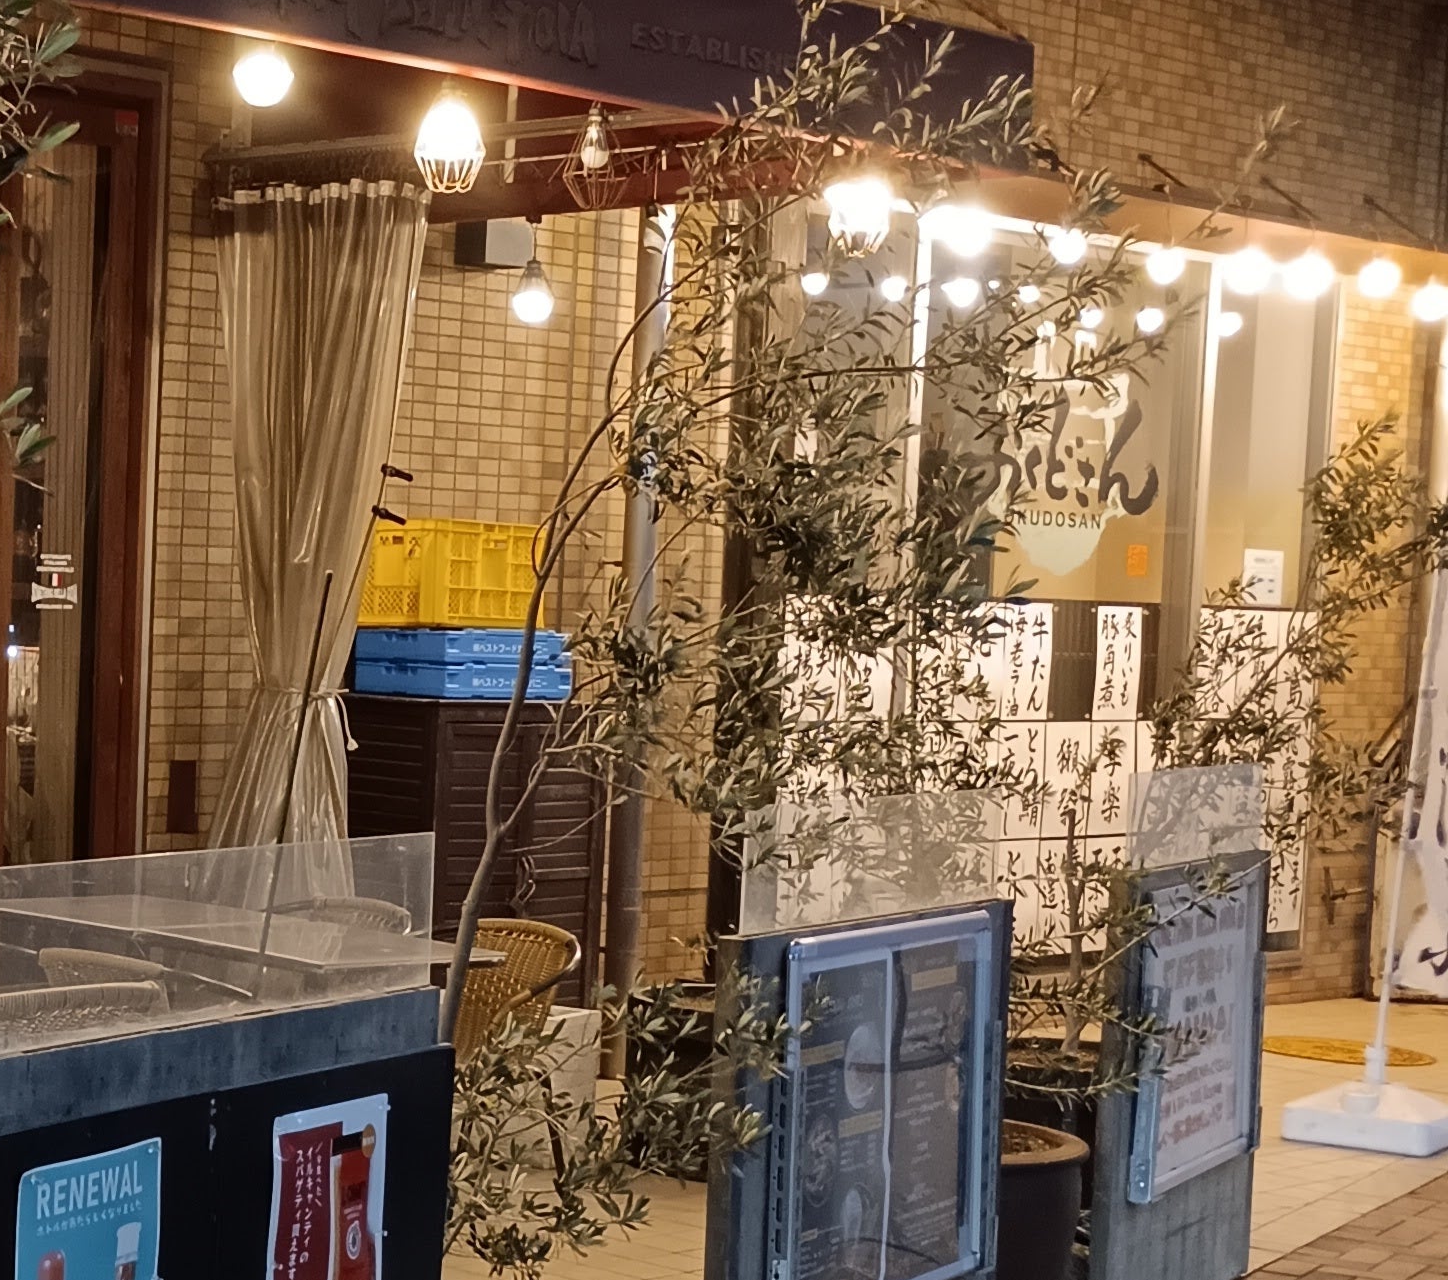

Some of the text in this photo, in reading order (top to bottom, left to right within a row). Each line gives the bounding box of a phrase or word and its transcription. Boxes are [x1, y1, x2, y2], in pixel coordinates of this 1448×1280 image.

[1026, 611, 1049, 712] 牛たん
[1097, 613, 1120, 711] 豚角煮
[36, 1160, 143, 1220] RENEWAL
